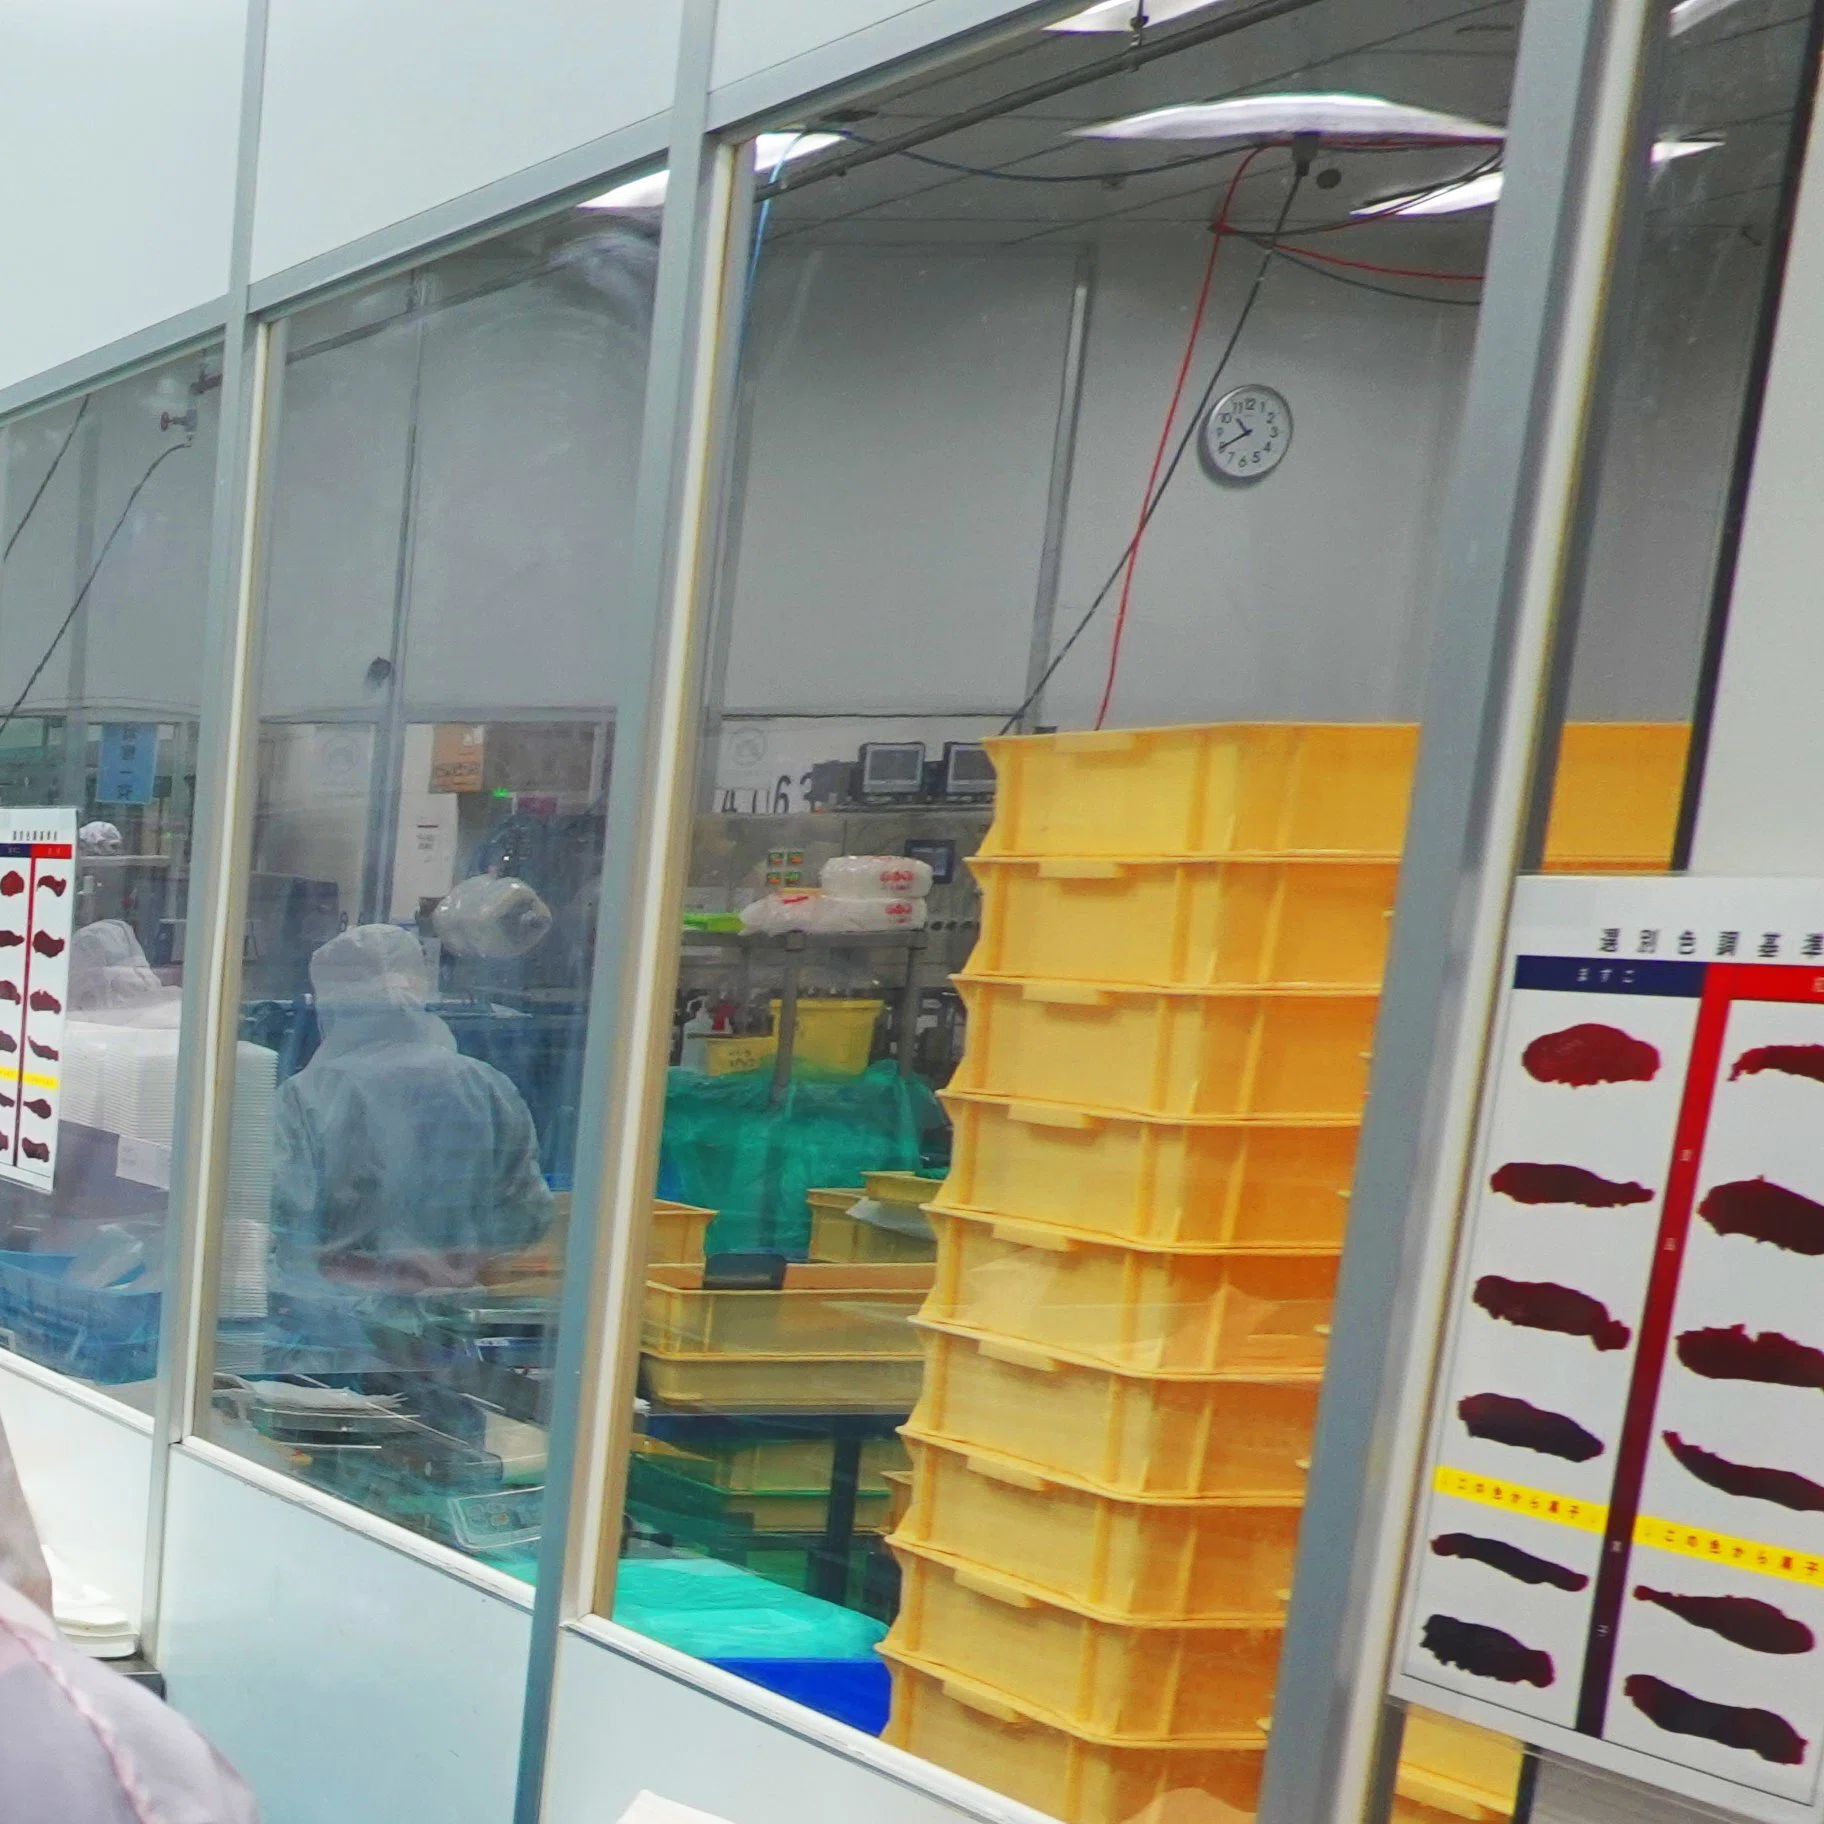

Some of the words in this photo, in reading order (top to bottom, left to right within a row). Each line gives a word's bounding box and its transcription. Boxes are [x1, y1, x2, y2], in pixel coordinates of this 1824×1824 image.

[1244, 397, 1256, 411] 12
[1260, 401, 1266, 413] 1
[1221, 413, 1232, 423] 10
[1266, 412, 1275, 424] 2
[1269, 427, 1278, 438] 3
[1262, 441, 1271, 452] 4
[1227, 452, 1235, 465] 7
[1238, 456, 1248, 468] 6
[1252, 451, 1261, 463] 5
